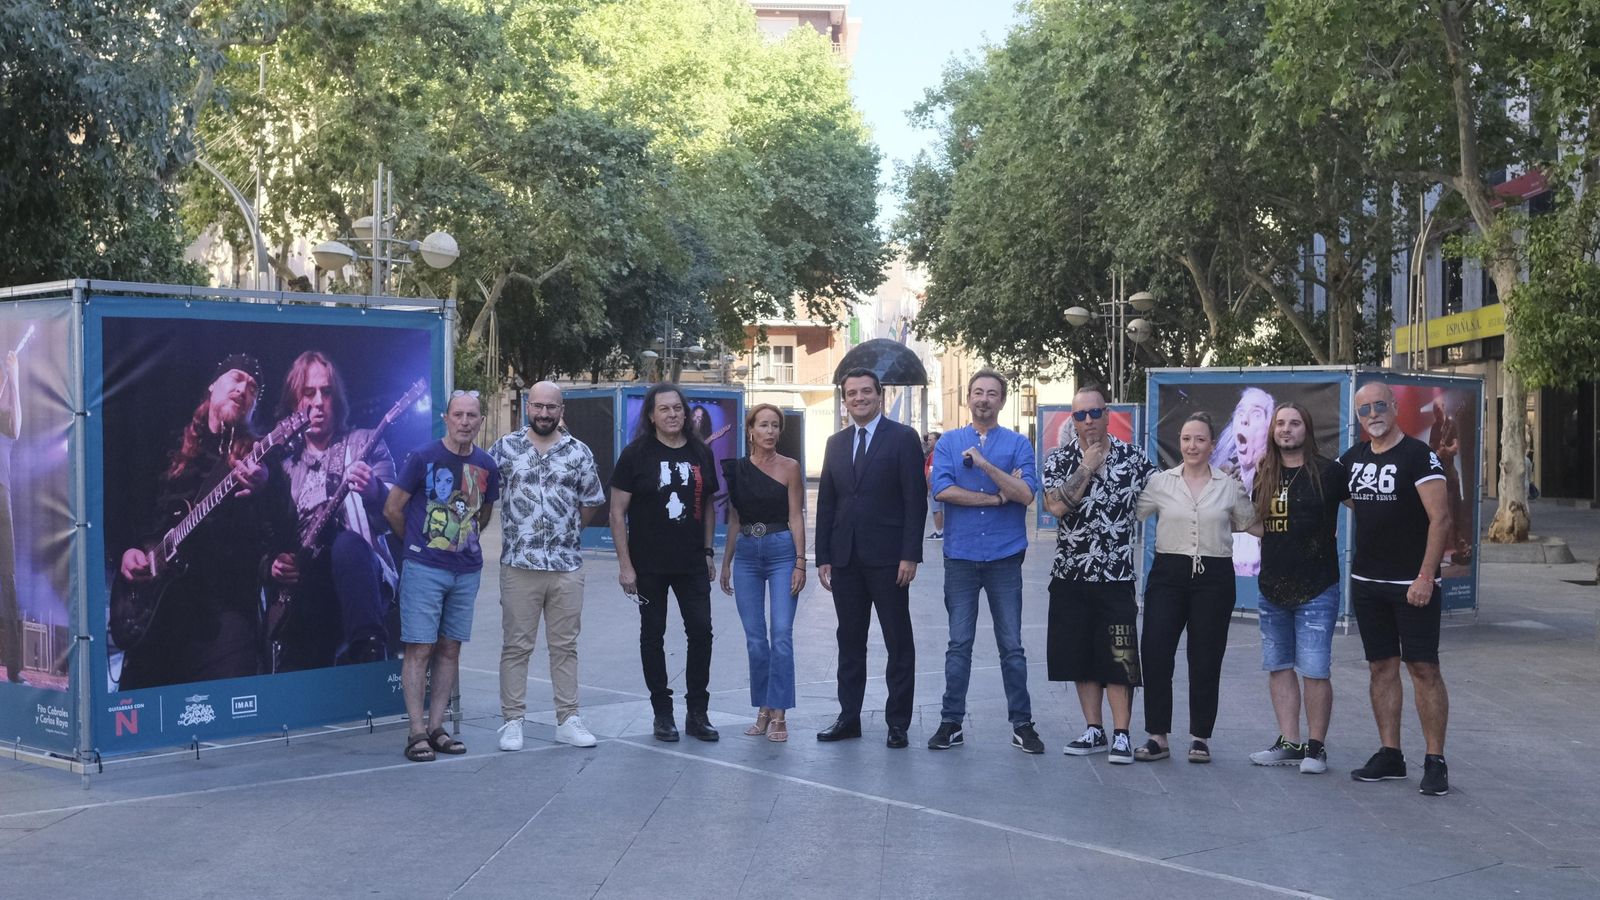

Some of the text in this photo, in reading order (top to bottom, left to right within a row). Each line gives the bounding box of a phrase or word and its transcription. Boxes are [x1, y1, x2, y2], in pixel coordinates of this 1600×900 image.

[37, 703, 47, 714] Fito
[108, 704, 134, 713] GUITARRAS
[235, 700, 254, 709] IMAE
[35, 714, 69, 729] y Carlos Raya
